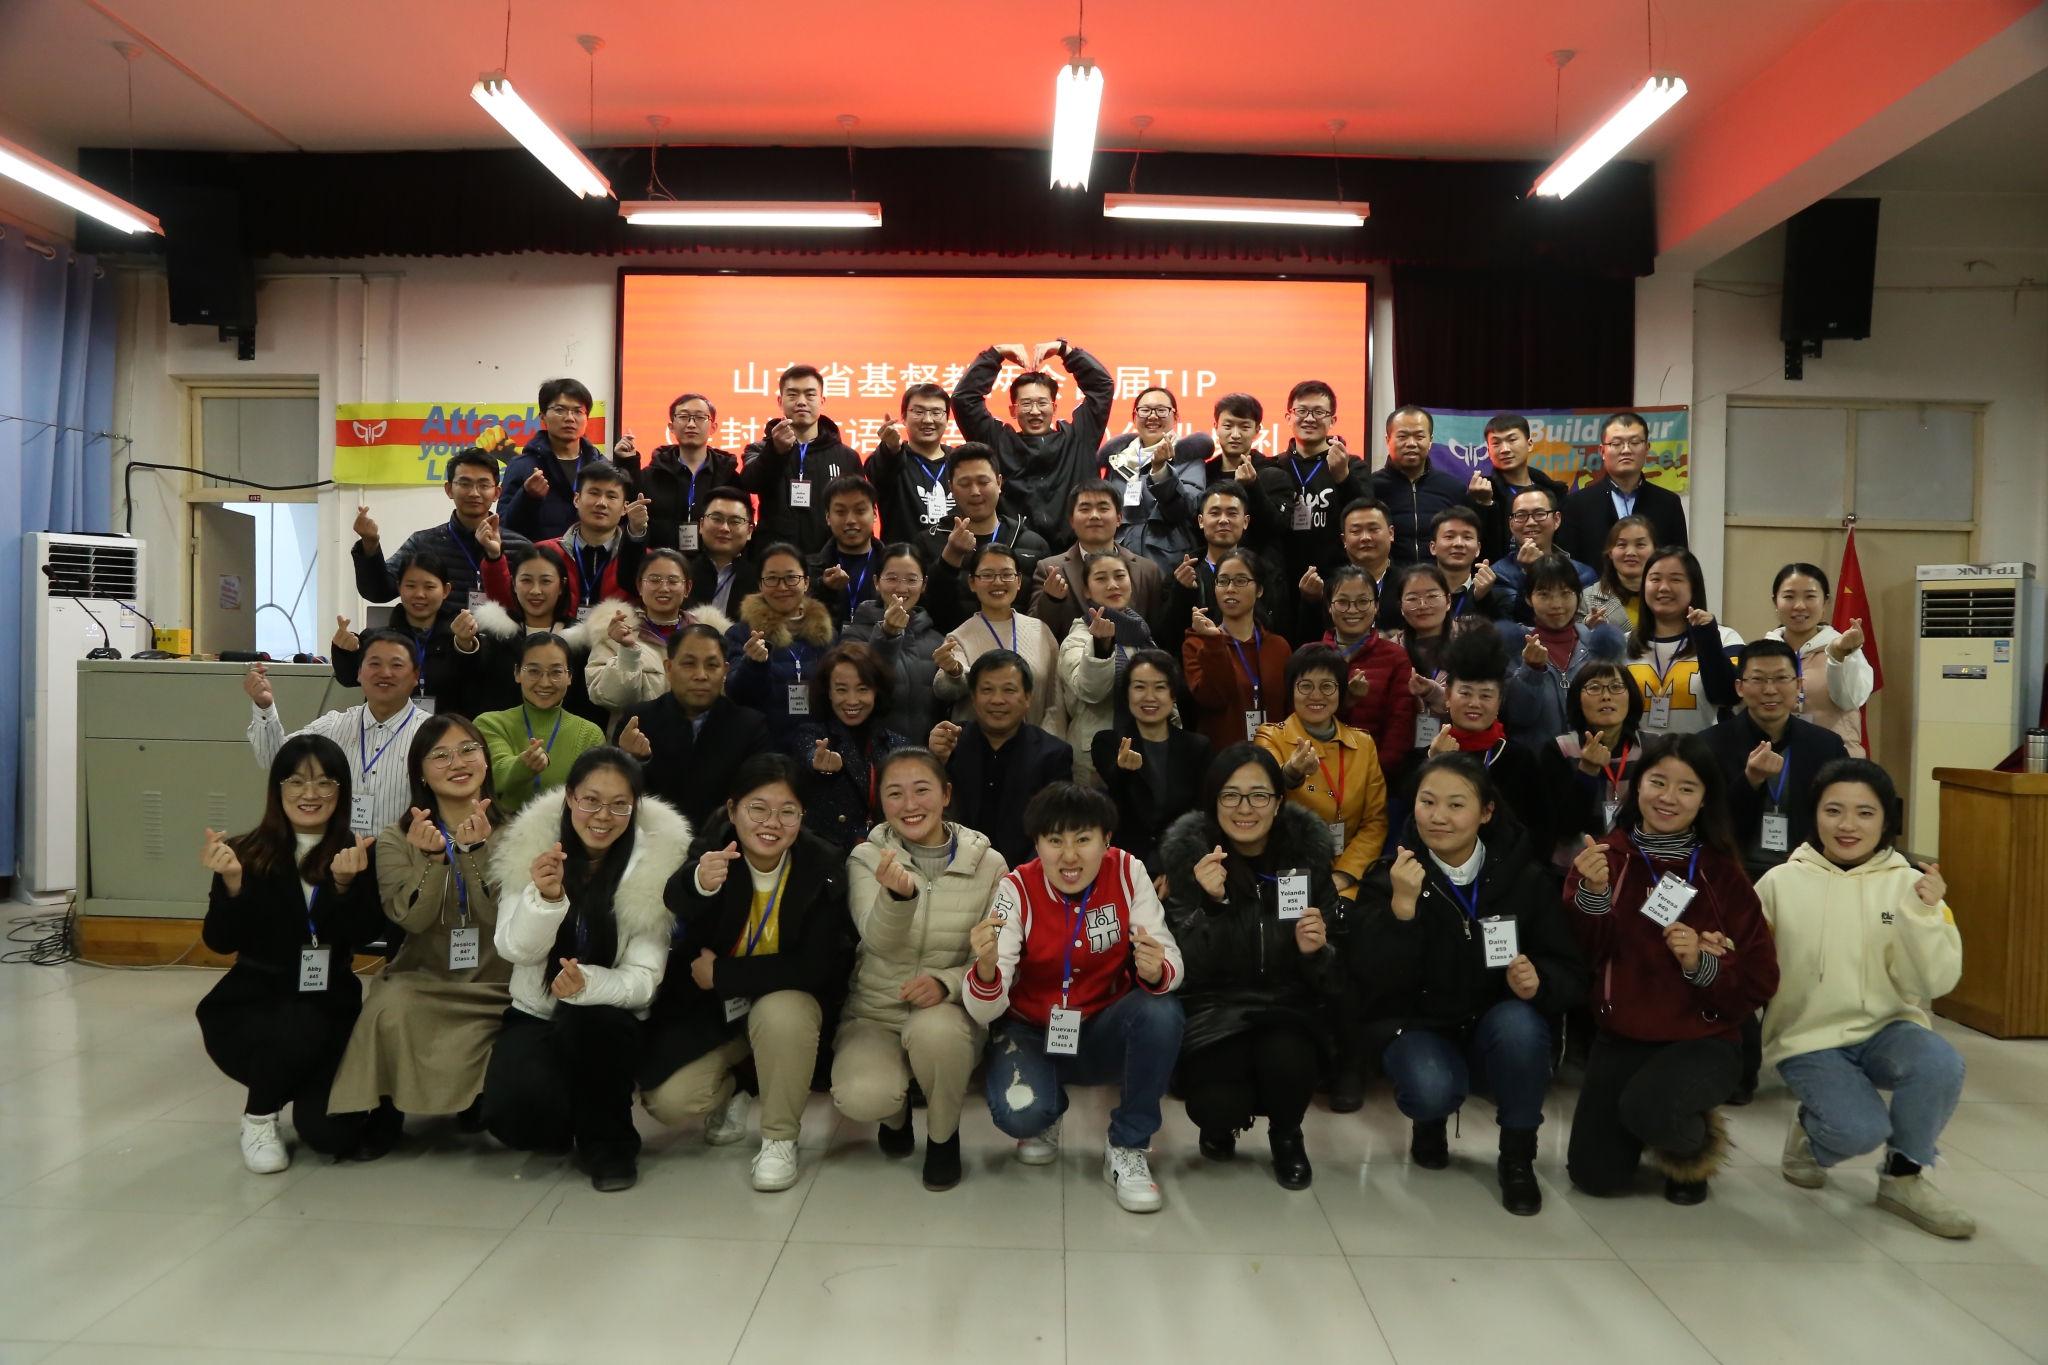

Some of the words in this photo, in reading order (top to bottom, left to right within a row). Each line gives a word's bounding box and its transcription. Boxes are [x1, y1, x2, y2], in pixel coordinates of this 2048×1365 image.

[420, 405, 543, 435] Attack
[1528, 418, 1600, 442] Build
[1529, 444, 1683, 473] onfidce!
[1957, 566, 2018, 576] TP-LINK
[1280, 889, 1306, 897] Yolanda
[1657, 892, 1679, 909] Teresa
[1648, 906, 1664, 919] Class
[1050, 1025, 1078, 1033] Guevara
